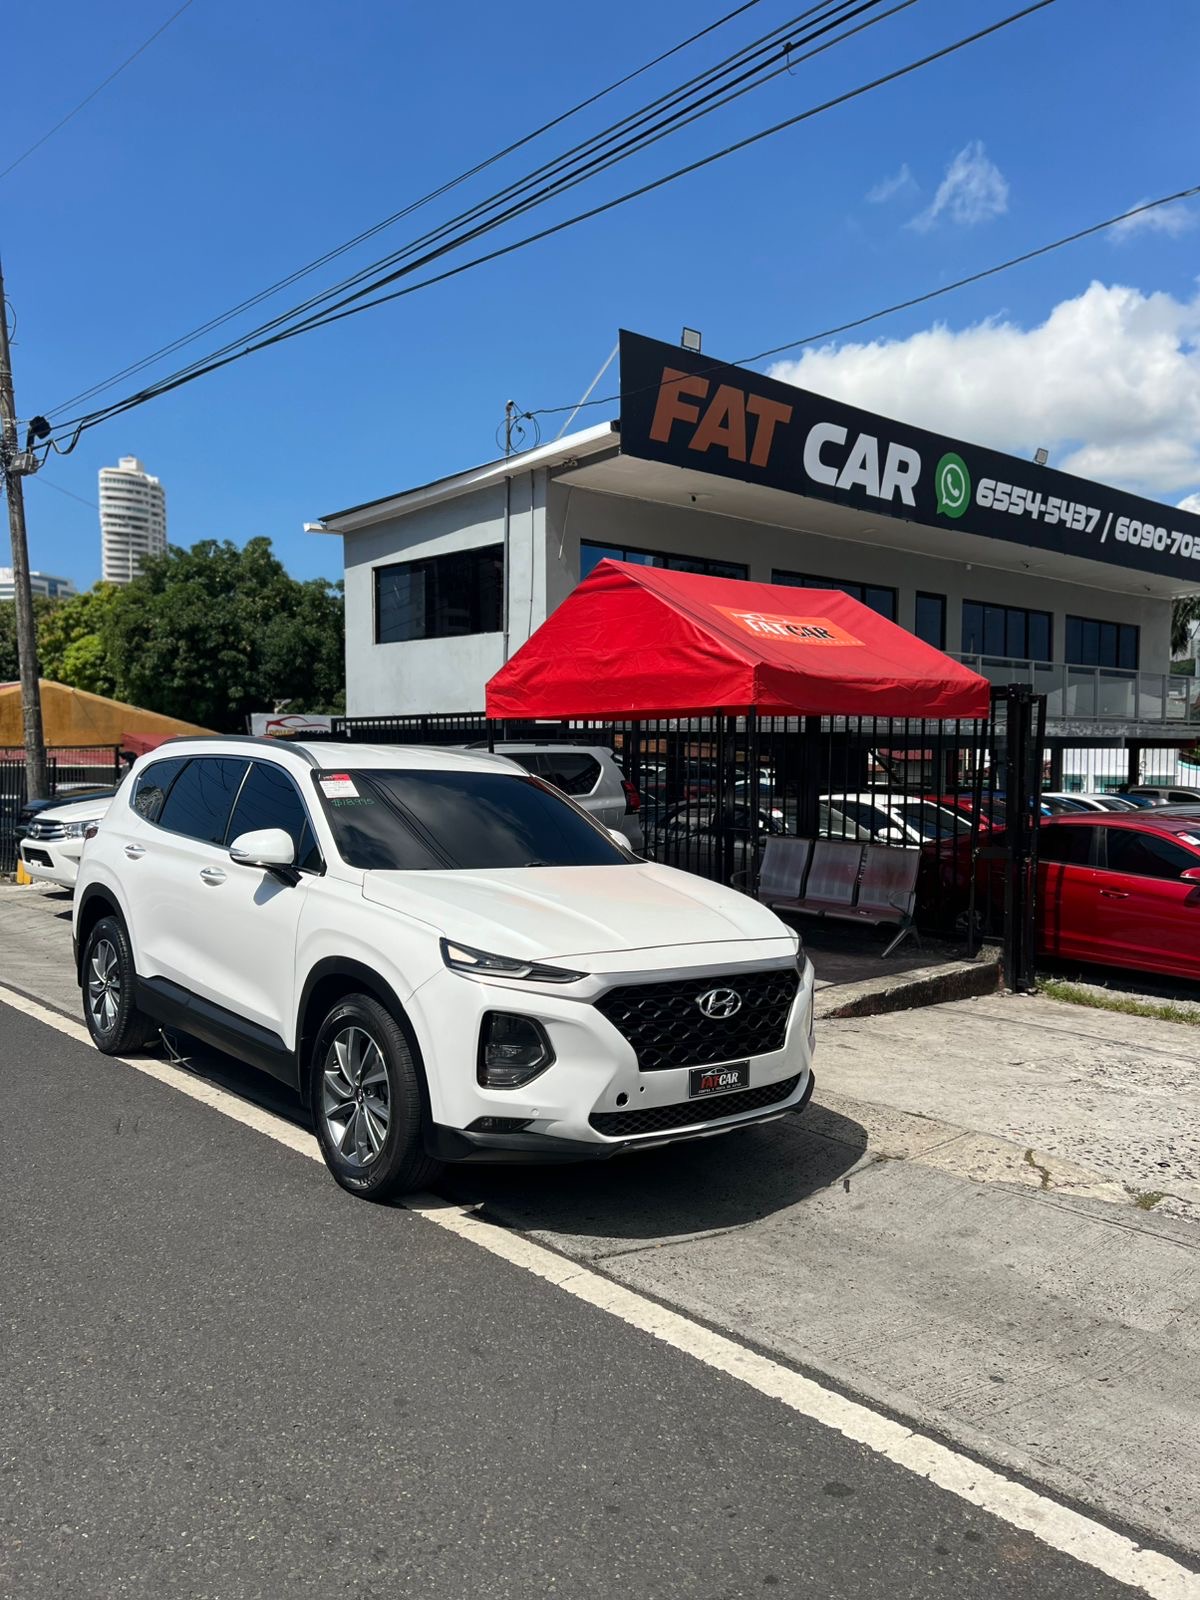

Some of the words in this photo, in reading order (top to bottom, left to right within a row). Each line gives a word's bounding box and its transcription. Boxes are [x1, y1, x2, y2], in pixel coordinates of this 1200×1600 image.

[649, 366, 793, 468] FAT
[803, 422, 922, 507] CAR
[976, 477, 1101, 534] 6554-5437
[1100, 512, 1114, 543] /
